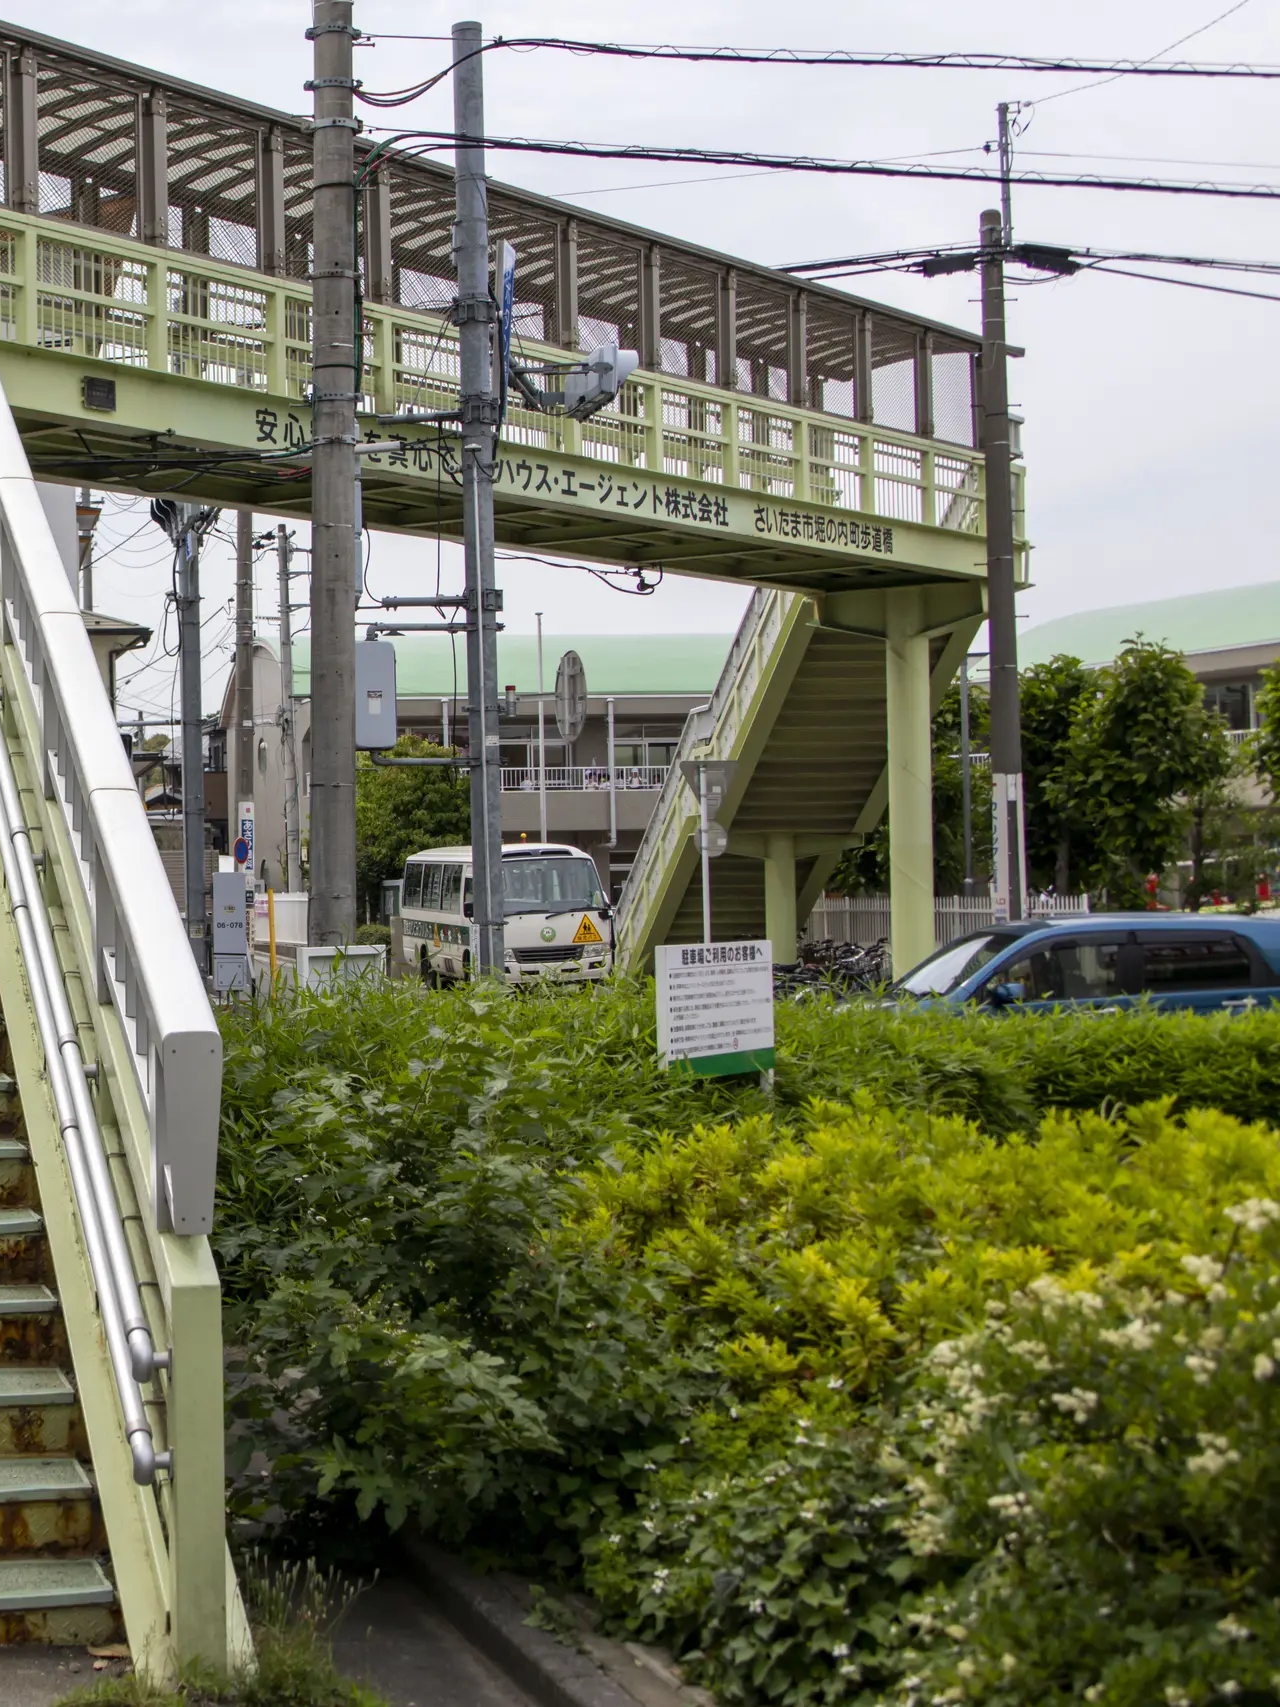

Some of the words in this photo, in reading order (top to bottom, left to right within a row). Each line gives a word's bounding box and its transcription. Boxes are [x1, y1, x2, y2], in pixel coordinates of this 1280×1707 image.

[754, 503, 893, 555] さいたま市堀の内町歩道橋
[681, 945, 764, 966] 駐車場ご利用のお客様へ
